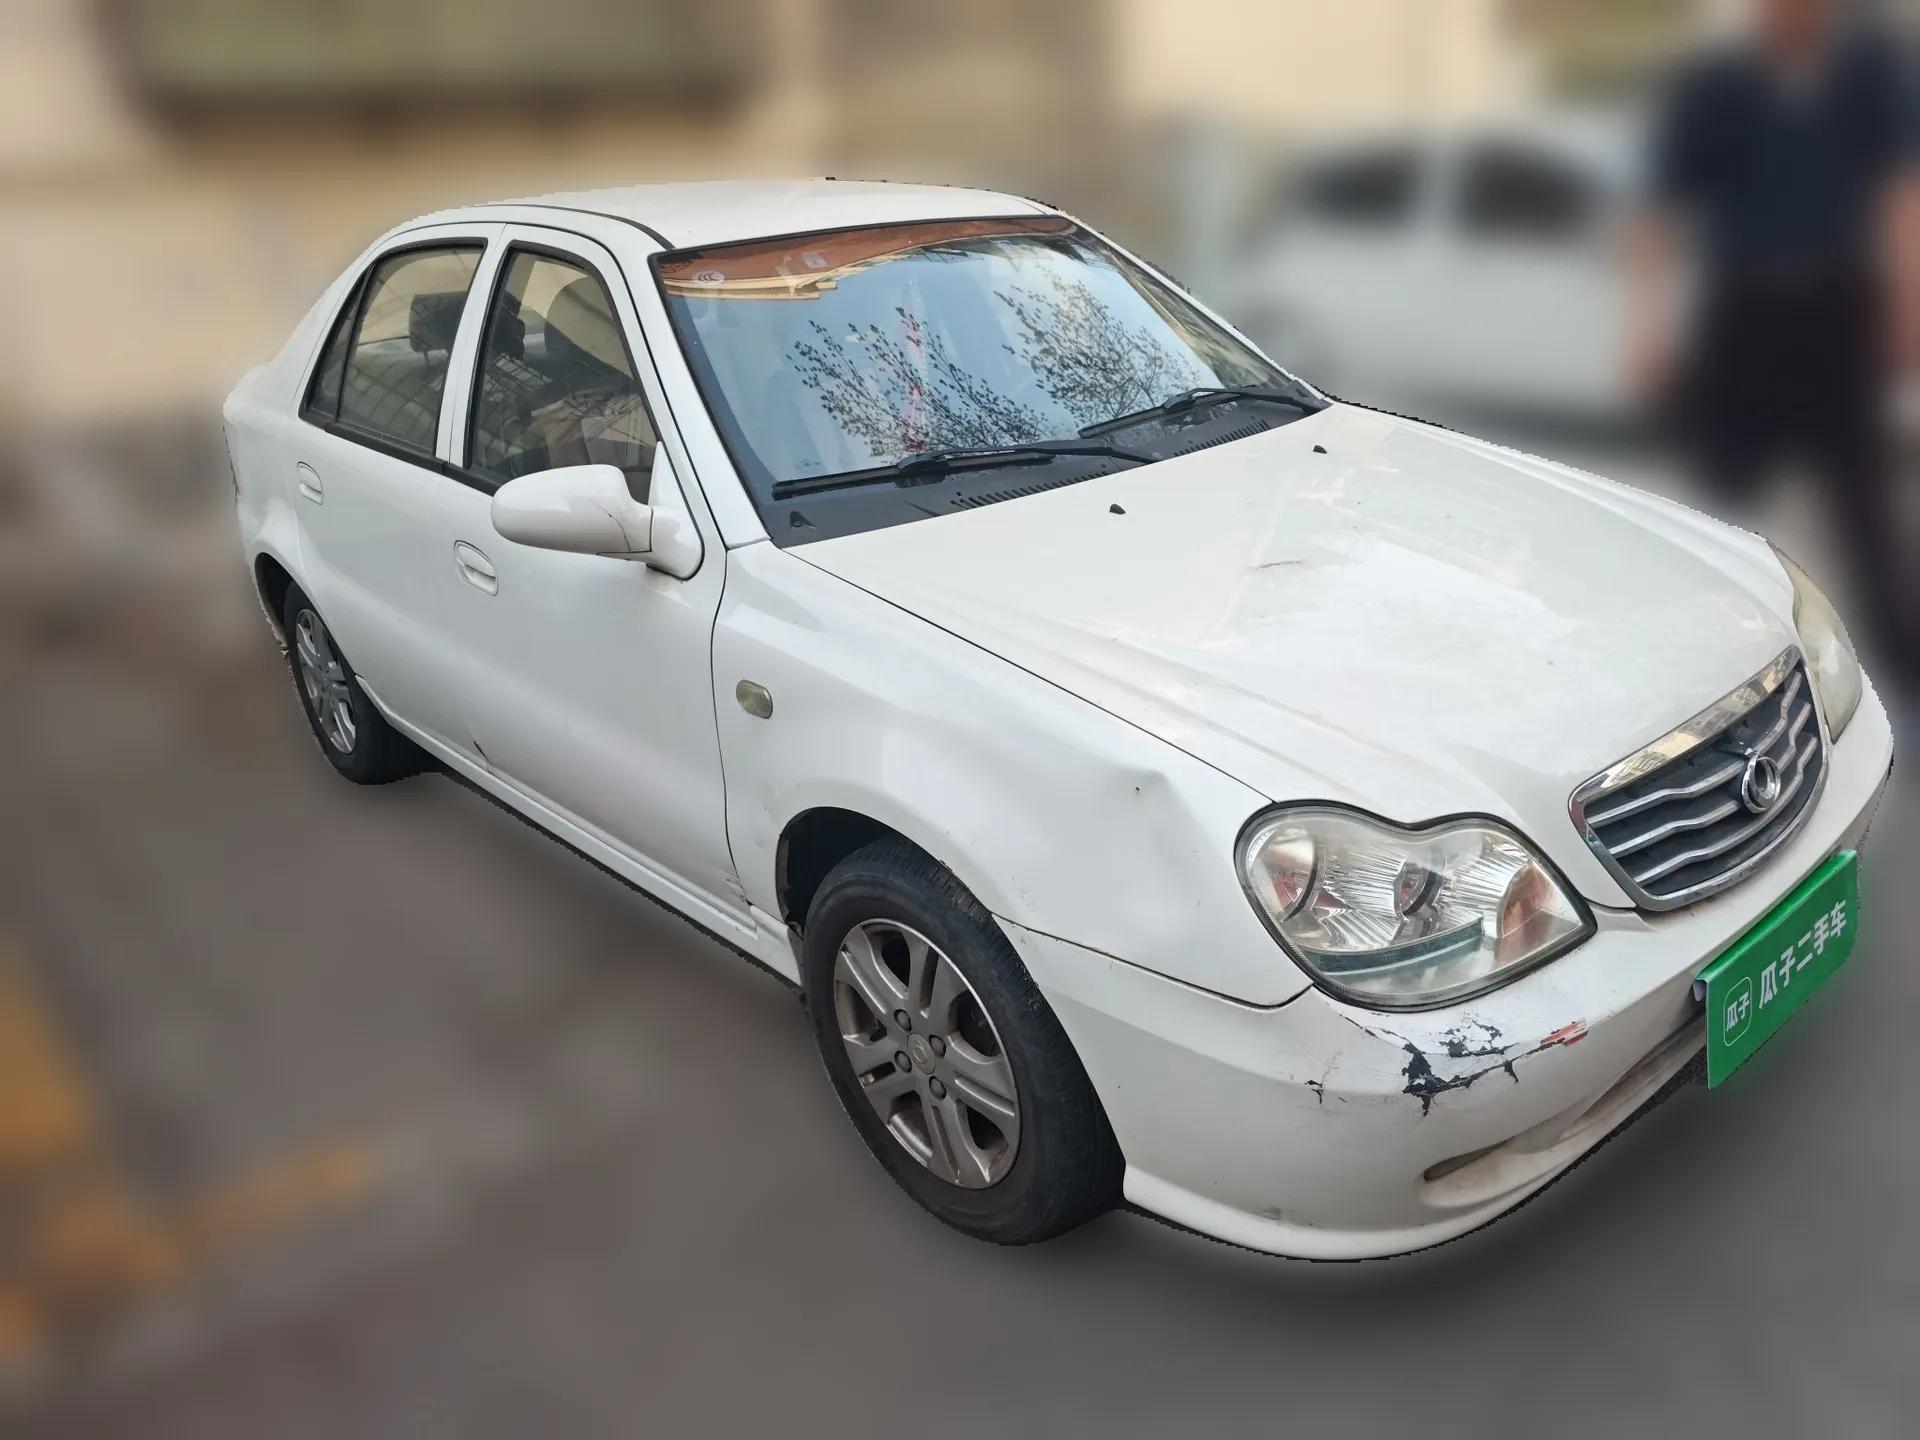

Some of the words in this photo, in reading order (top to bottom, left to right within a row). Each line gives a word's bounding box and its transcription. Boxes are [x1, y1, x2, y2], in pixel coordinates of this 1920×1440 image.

[1759, 900, 1847, 1009] 瓜子二手车
[1726, 992, 1750, 1032] 瓜子
